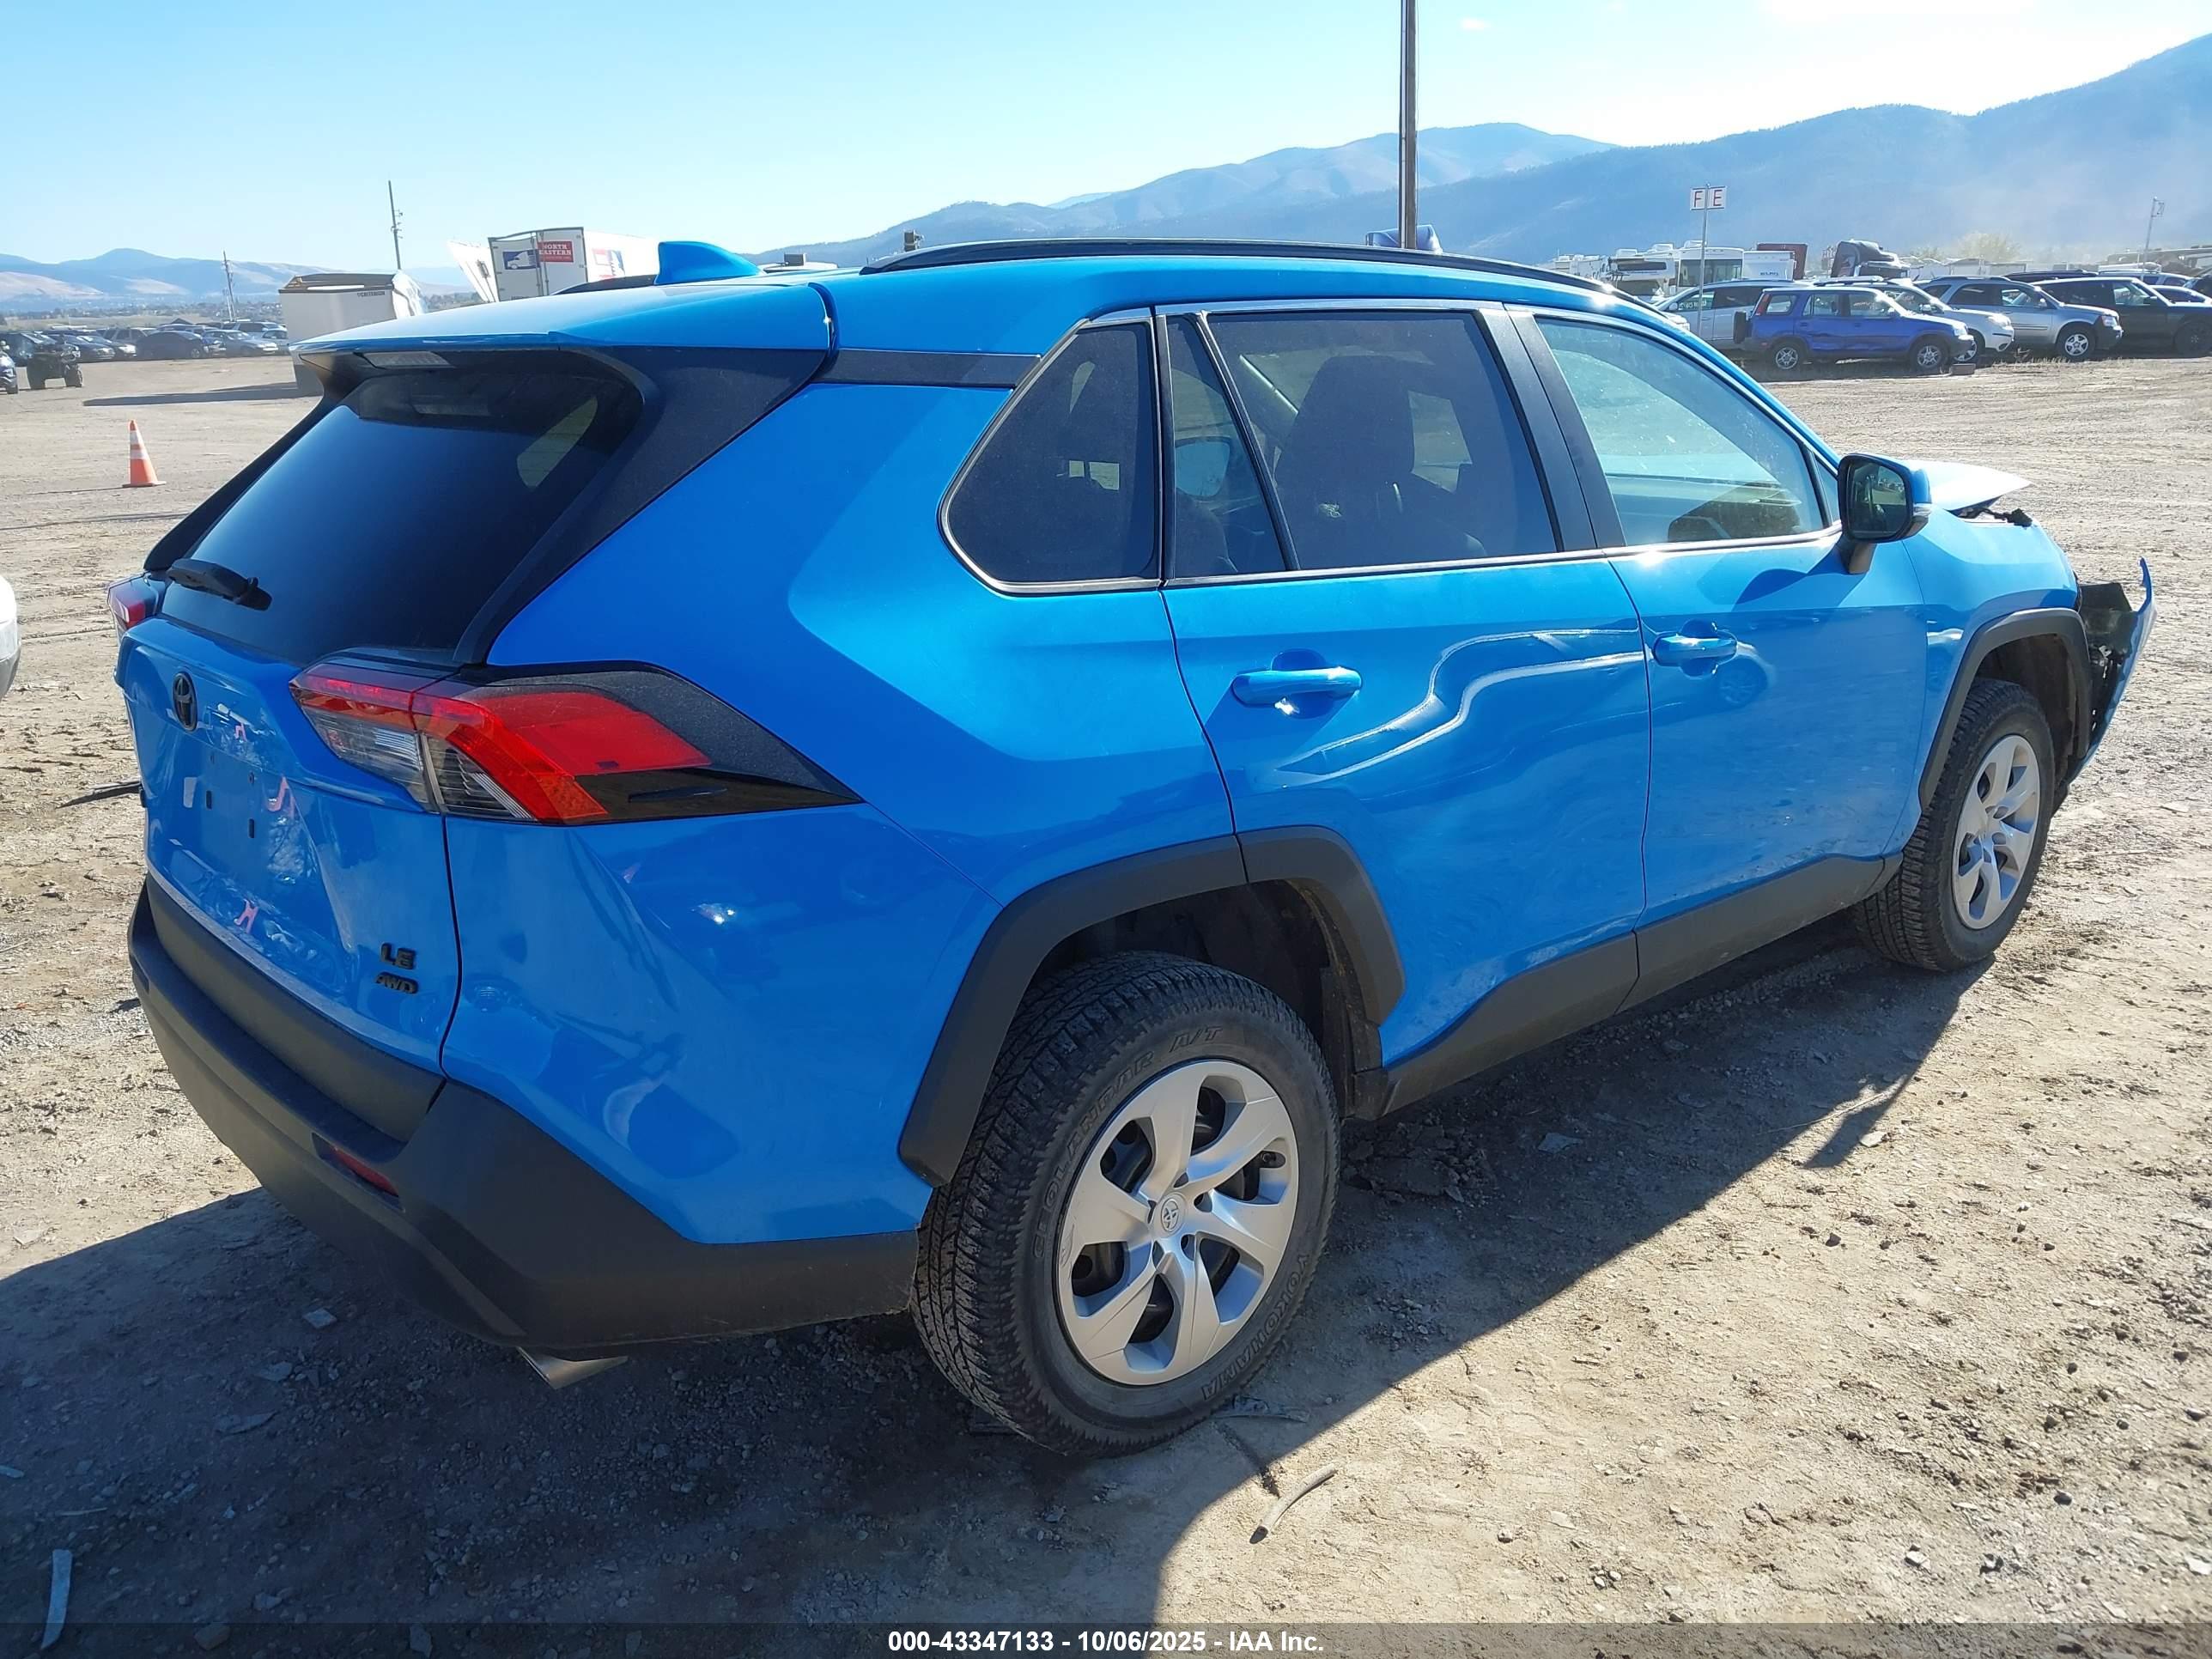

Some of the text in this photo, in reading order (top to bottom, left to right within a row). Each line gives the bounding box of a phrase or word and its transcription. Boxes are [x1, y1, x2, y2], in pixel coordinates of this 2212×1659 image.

[1693, 189, 1723, 207] F E
[381, 942, 416, 970] LE
[374, 971, 419, 994] AWD
[1200, 1253, 1310, 1401] YOKOHAMA
